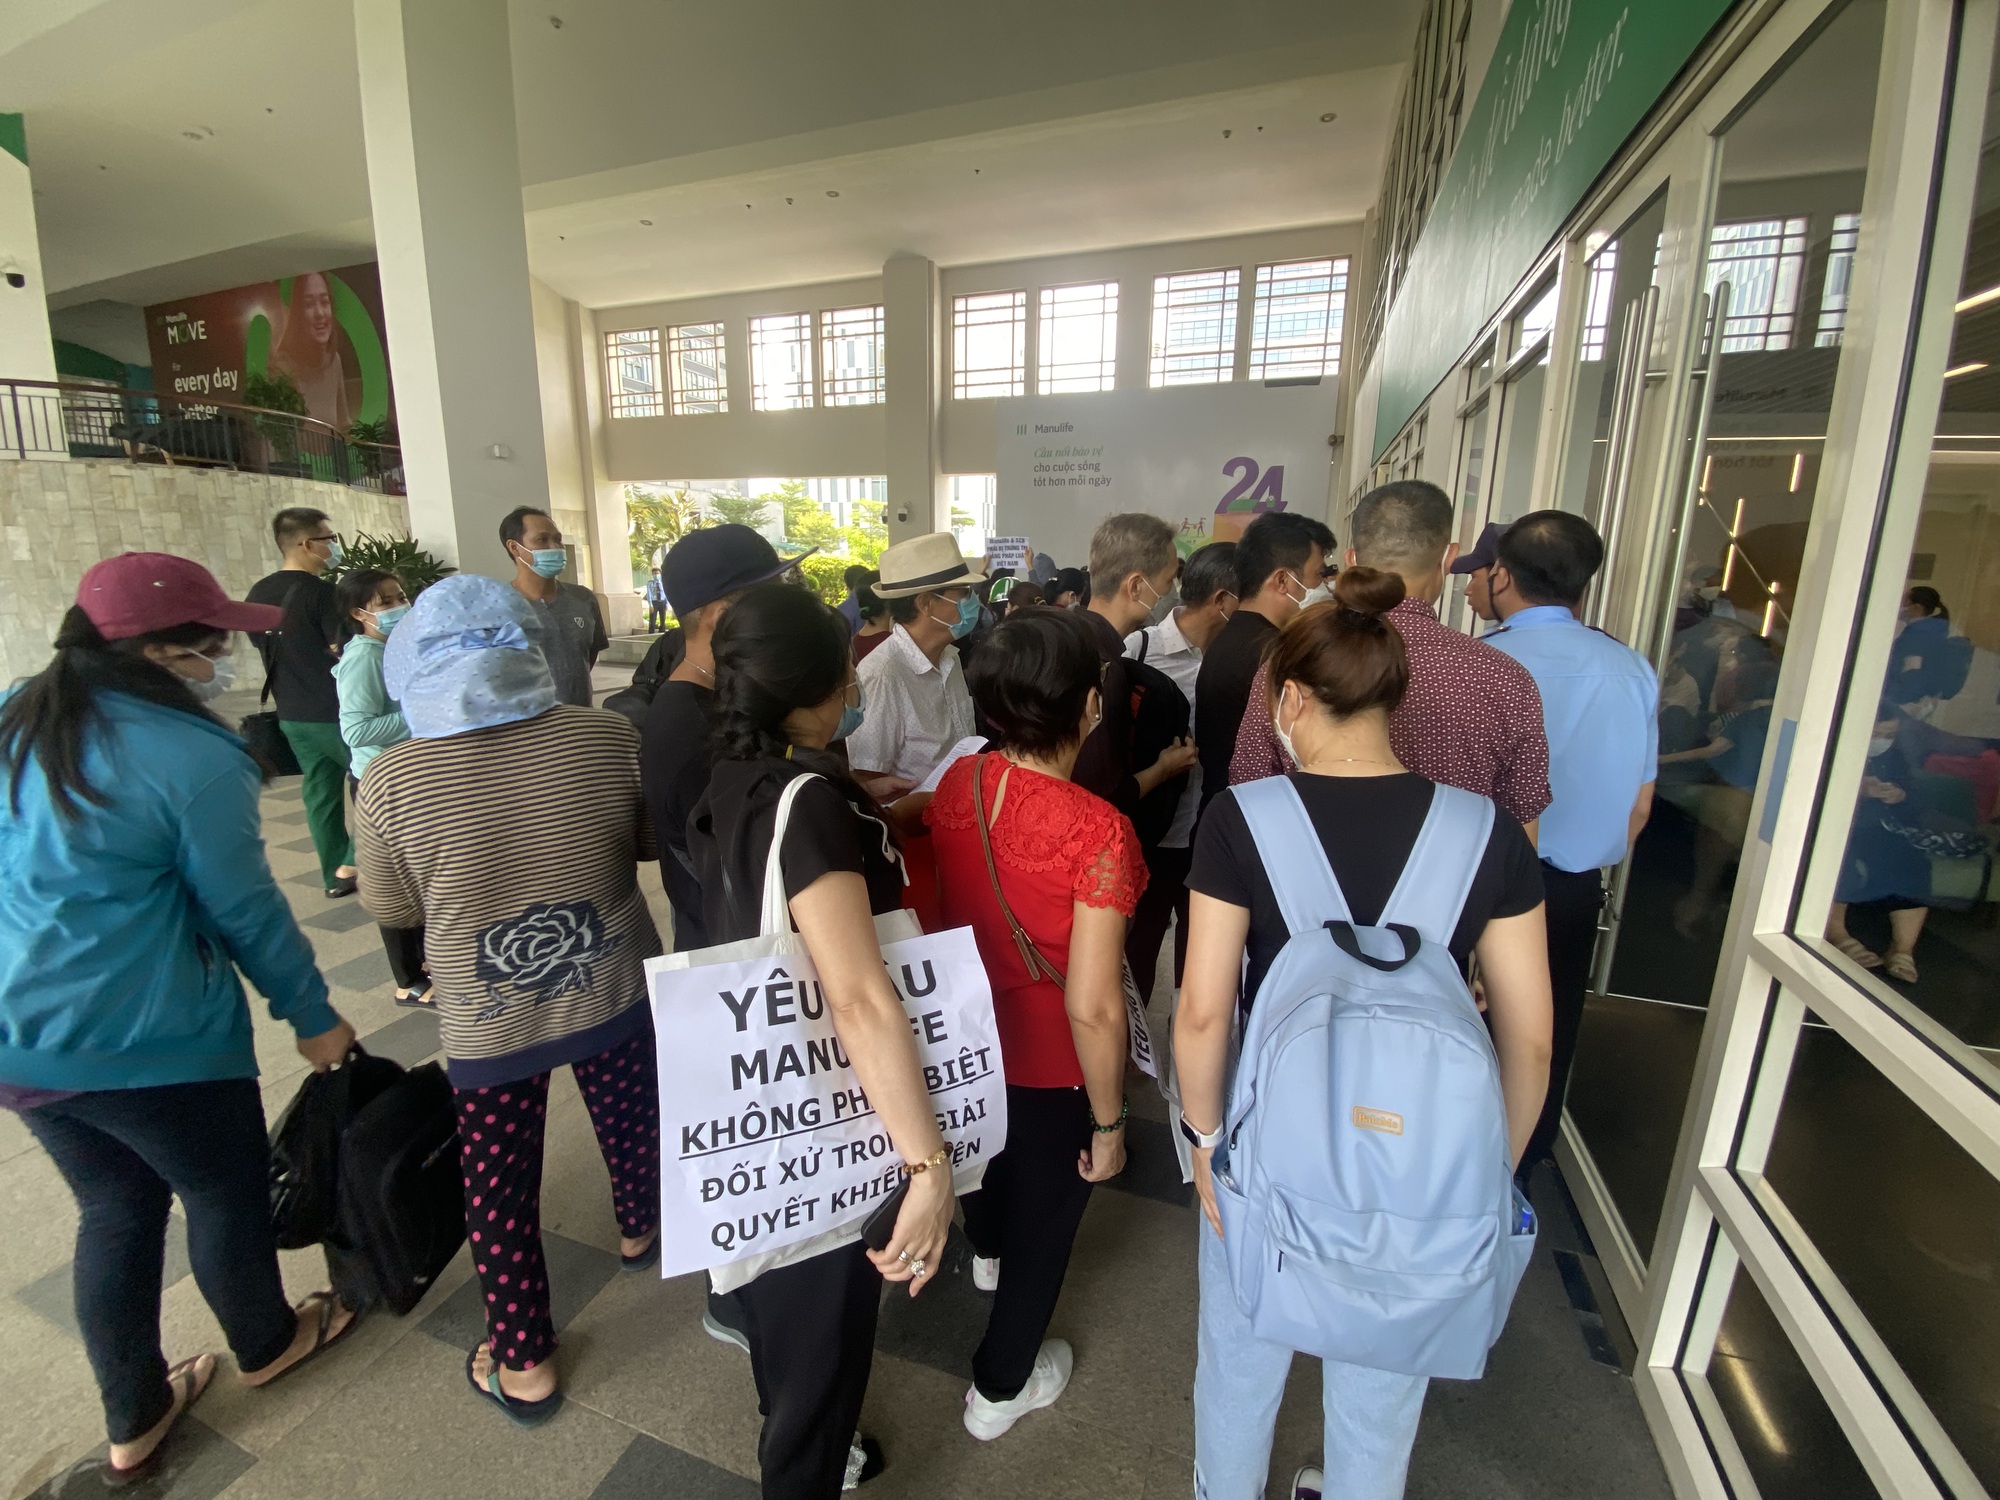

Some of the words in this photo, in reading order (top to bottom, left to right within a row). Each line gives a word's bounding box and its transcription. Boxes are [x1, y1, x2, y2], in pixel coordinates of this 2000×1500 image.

[1554, 5, 1629, 164] better.
[167, 320, 208, 344] MOVE
[174, 374, 210, 394] every
[213, 367, 238, 391] day
[1034, 422, 1074, 434] Manulife
[1033, 462, 1051, 472] cho
[1053, 462, 1075, 473] cuộc
[1077, 460, 1101, 472] sống
[1033, 476, 1046, 487] tốt
[1048, 477, 1065, 486] hơn
[1068, 474, 1086, 485] mỗi
[1088, 474, 1112, 487] ngày
[1214, 455, 1289, 514] 24
[718, 967, 824, 1033] YÊU
[681, 1097, 822, 1156] KHÔNG
[923, 1046, 992, 1091] BIỆT
[700, 1161, 767, 1203] ĐỐI
[779, 1146, 823, 1185] XỬ
[711, 1189, 821, 1252] QUYẾT
